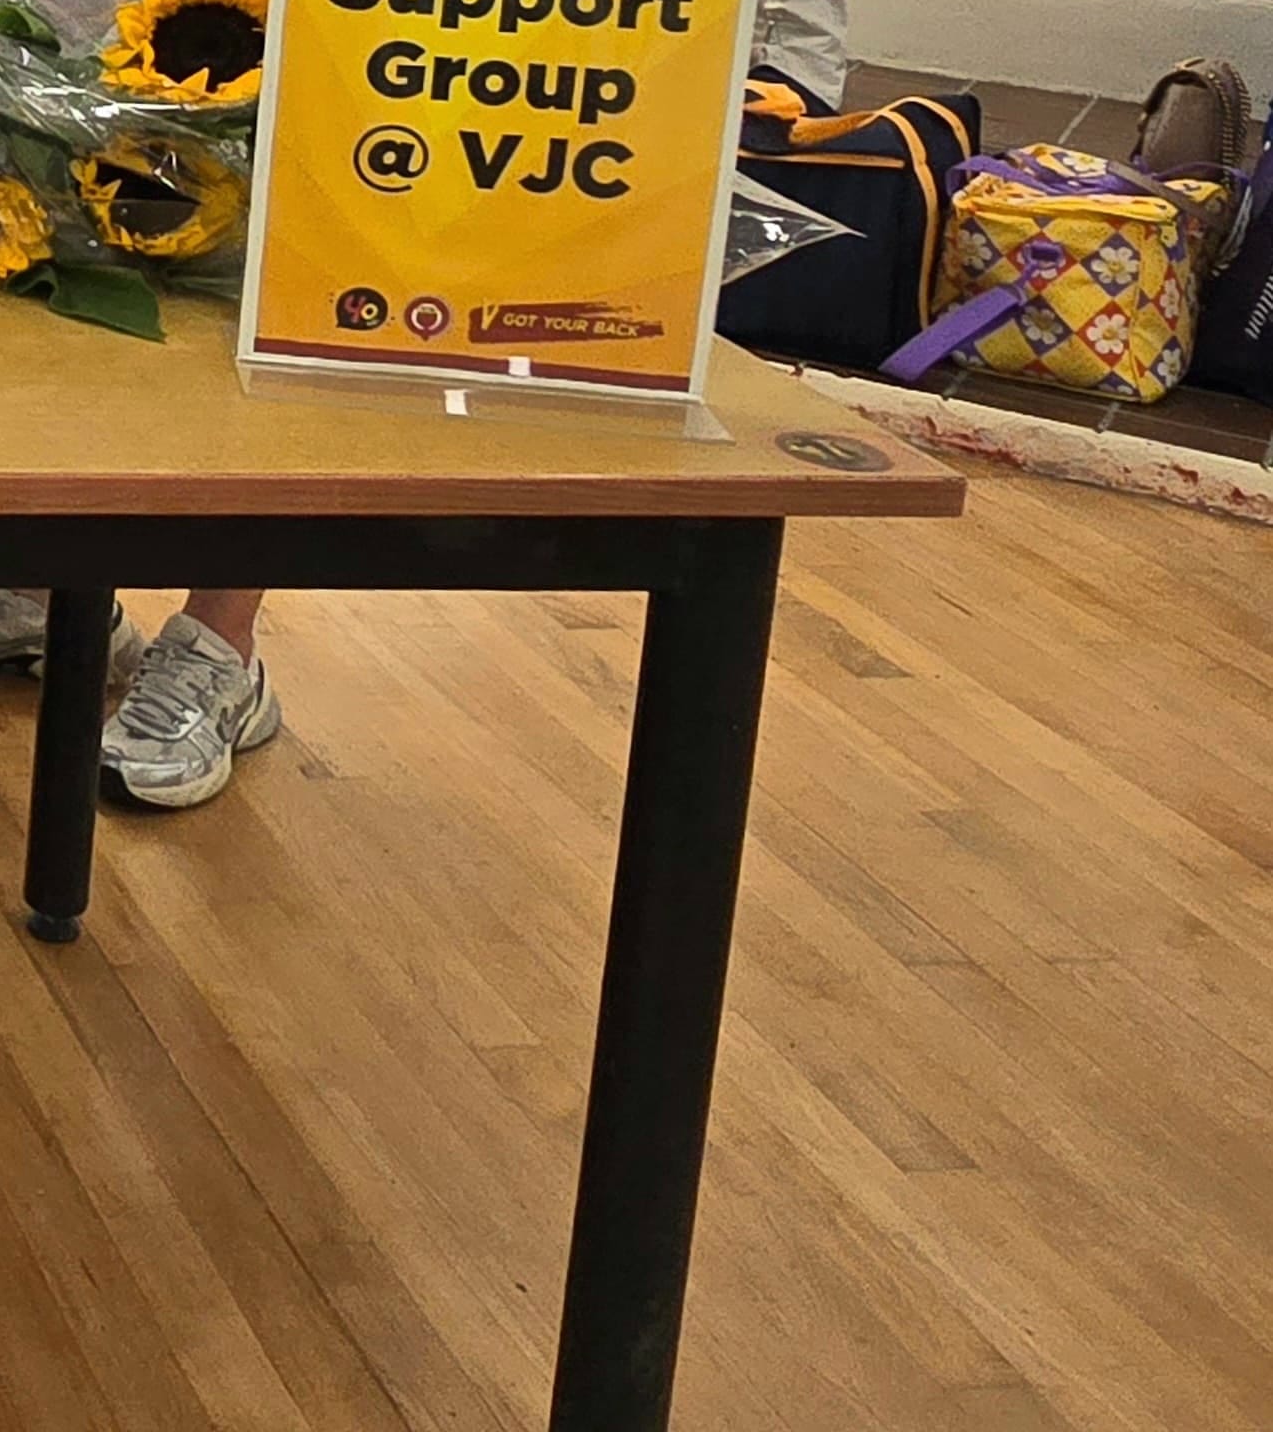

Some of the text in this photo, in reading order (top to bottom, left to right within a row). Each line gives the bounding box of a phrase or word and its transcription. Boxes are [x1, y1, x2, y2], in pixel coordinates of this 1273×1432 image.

[366, 40, 636, 125] Group
[353, 124, 635, 199] @ VJC
[502, 312, 539, 328] GOT
[543, 316, 590, 333] YOUR
[592, 320, 641, 338] BACK
